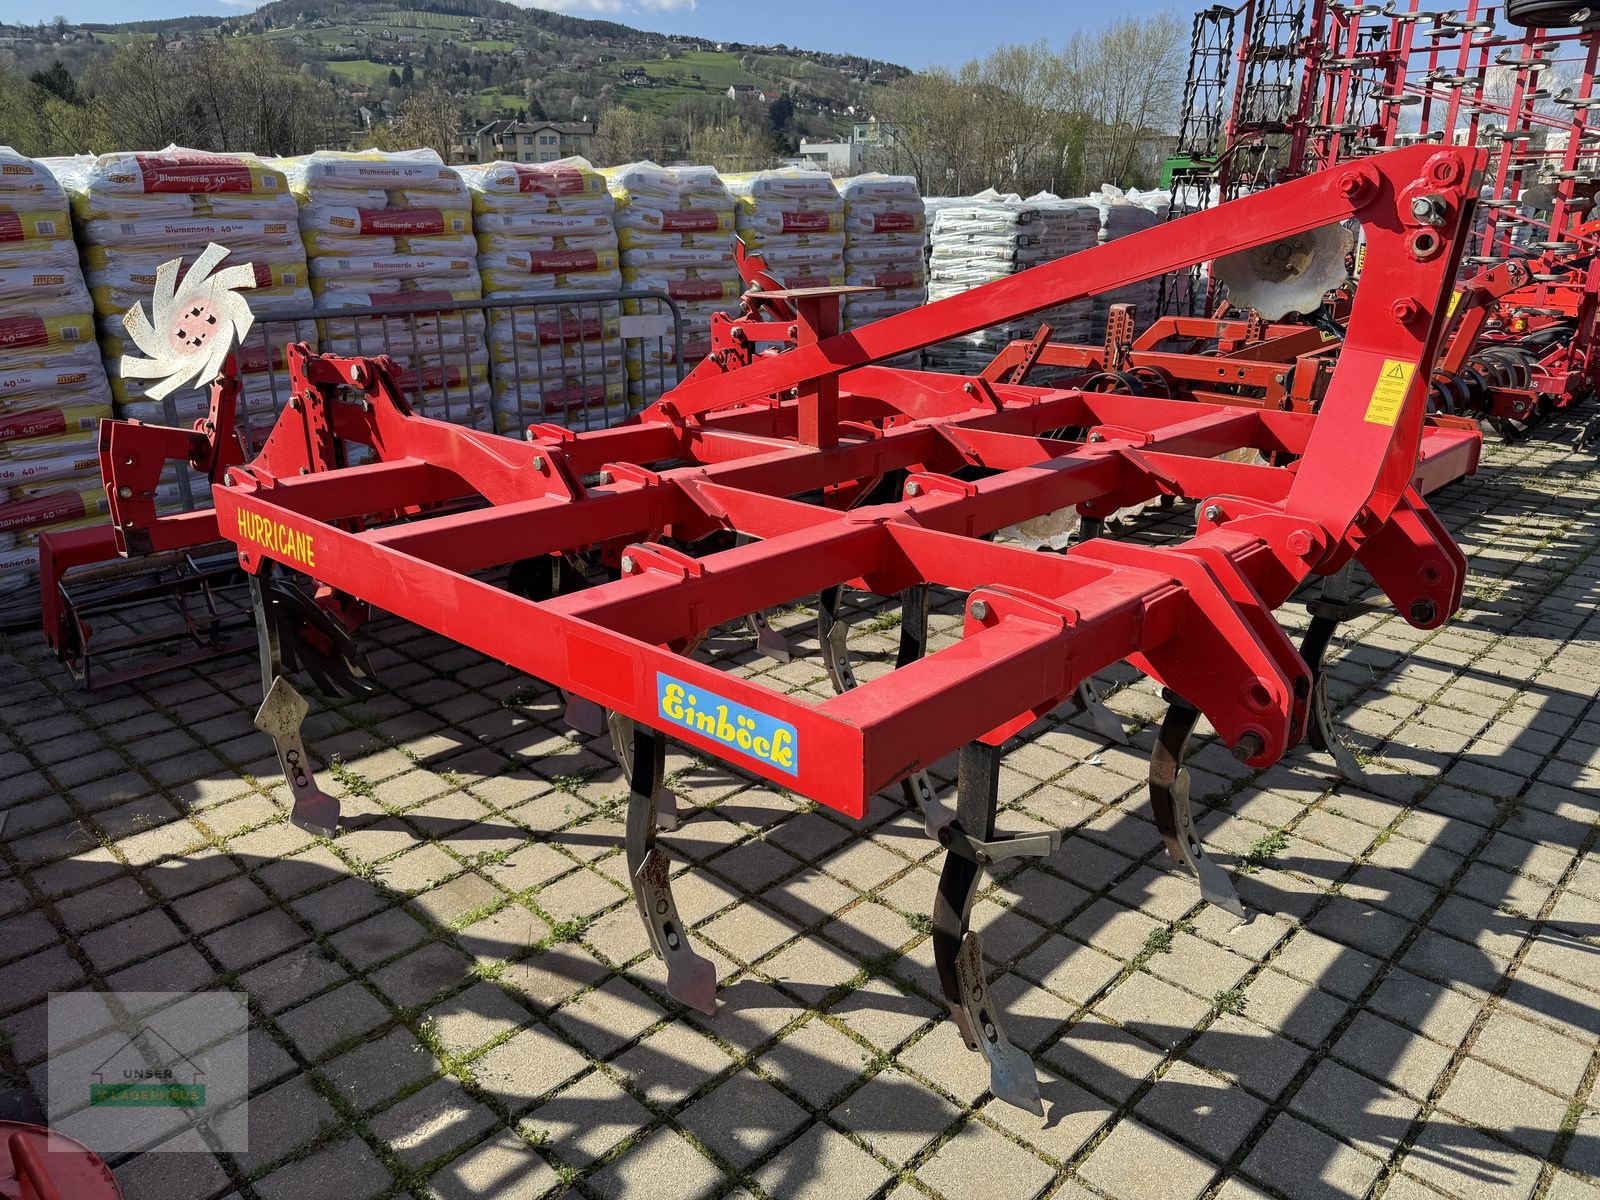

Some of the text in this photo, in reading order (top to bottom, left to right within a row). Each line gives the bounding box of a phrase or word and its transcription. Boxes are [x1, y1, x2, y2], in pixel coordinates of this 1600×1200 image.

[2, 164, 33, 174] impos
[359, 168, 400, 176] Blumenerde
[159, 174, 210, 183] Blumenerde
[165, 225, 215, 233] Blumenerde
[373, 221, 412, 229] Blumenerde
[373, 261, 412, 269] Blumenerde
[22, 426, 35, 434] 40
[22, 468, 34, 476] 40
[43, 511, 55, 520] 40
[237, 506, 316, 568] HURRICANE
[662, 683, 793, 768] Einböck
